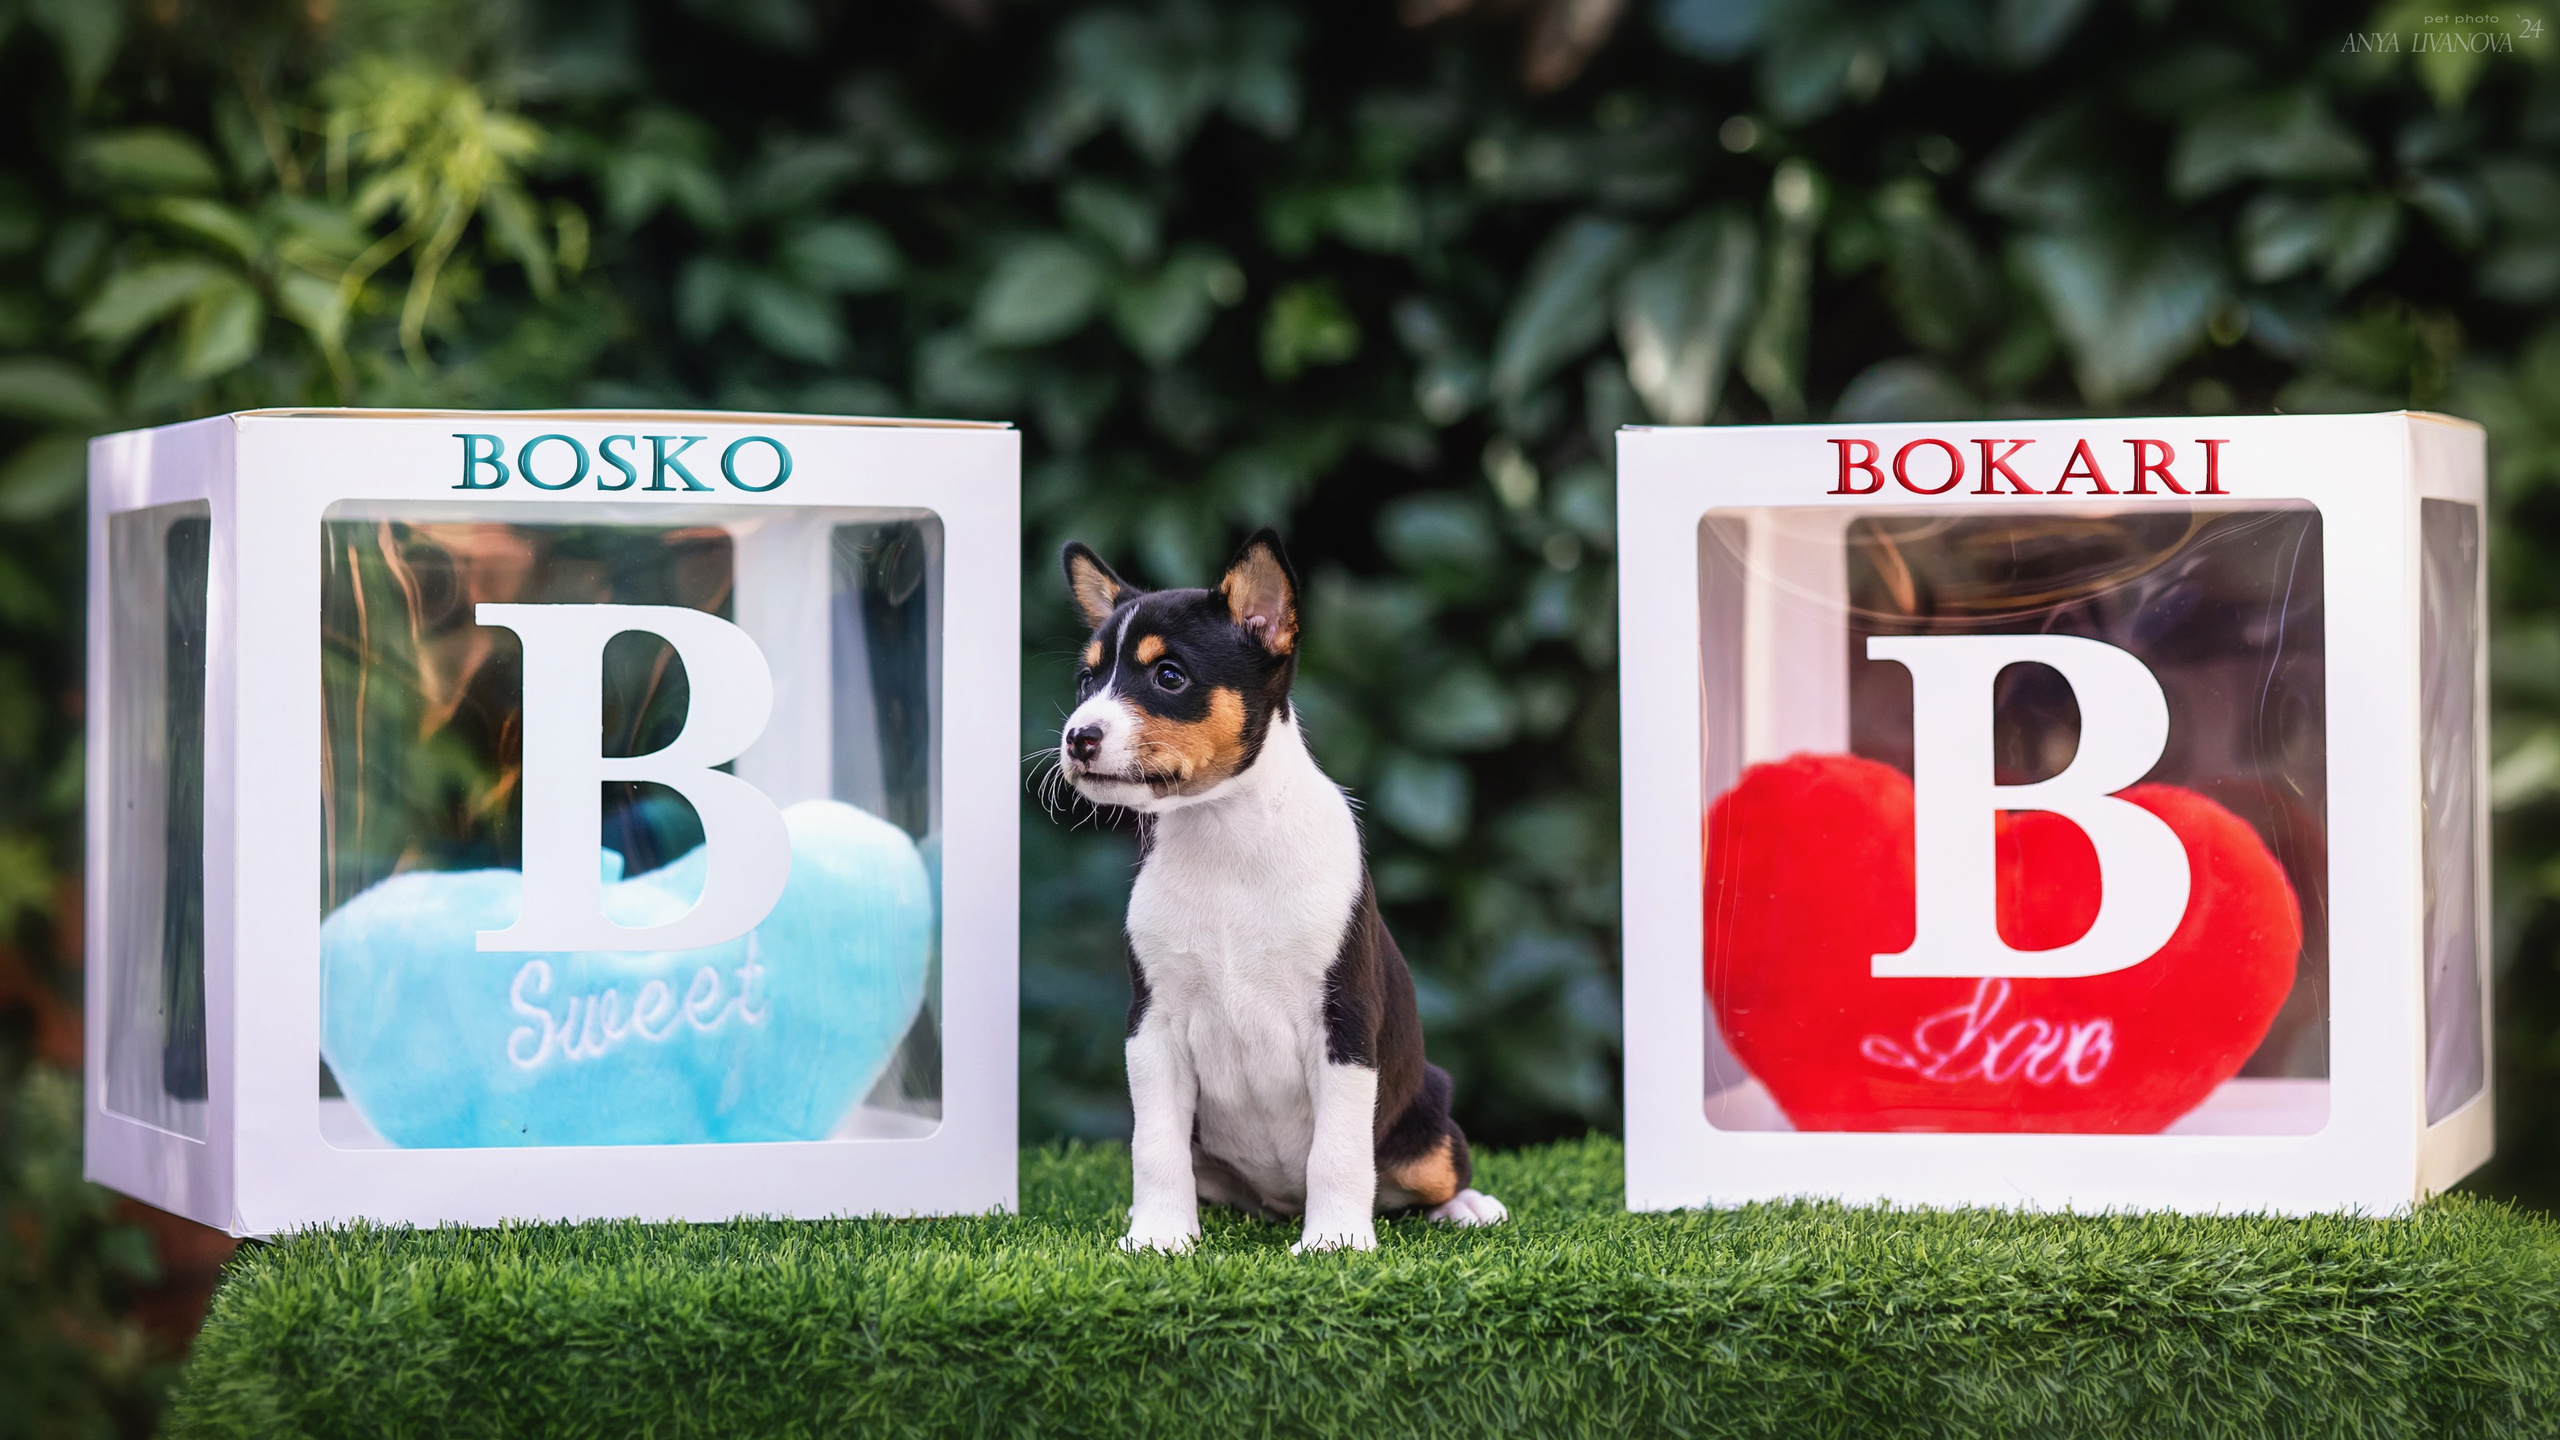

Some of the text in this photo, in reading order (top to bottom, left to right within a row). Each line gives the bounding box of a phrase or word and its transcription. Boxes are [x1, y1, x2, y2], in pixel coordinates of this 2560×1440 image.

[475, 603, 791, 952] B
[1866, 634, 2191, 979] B
[507, 929, 766, 1070] Sweet
